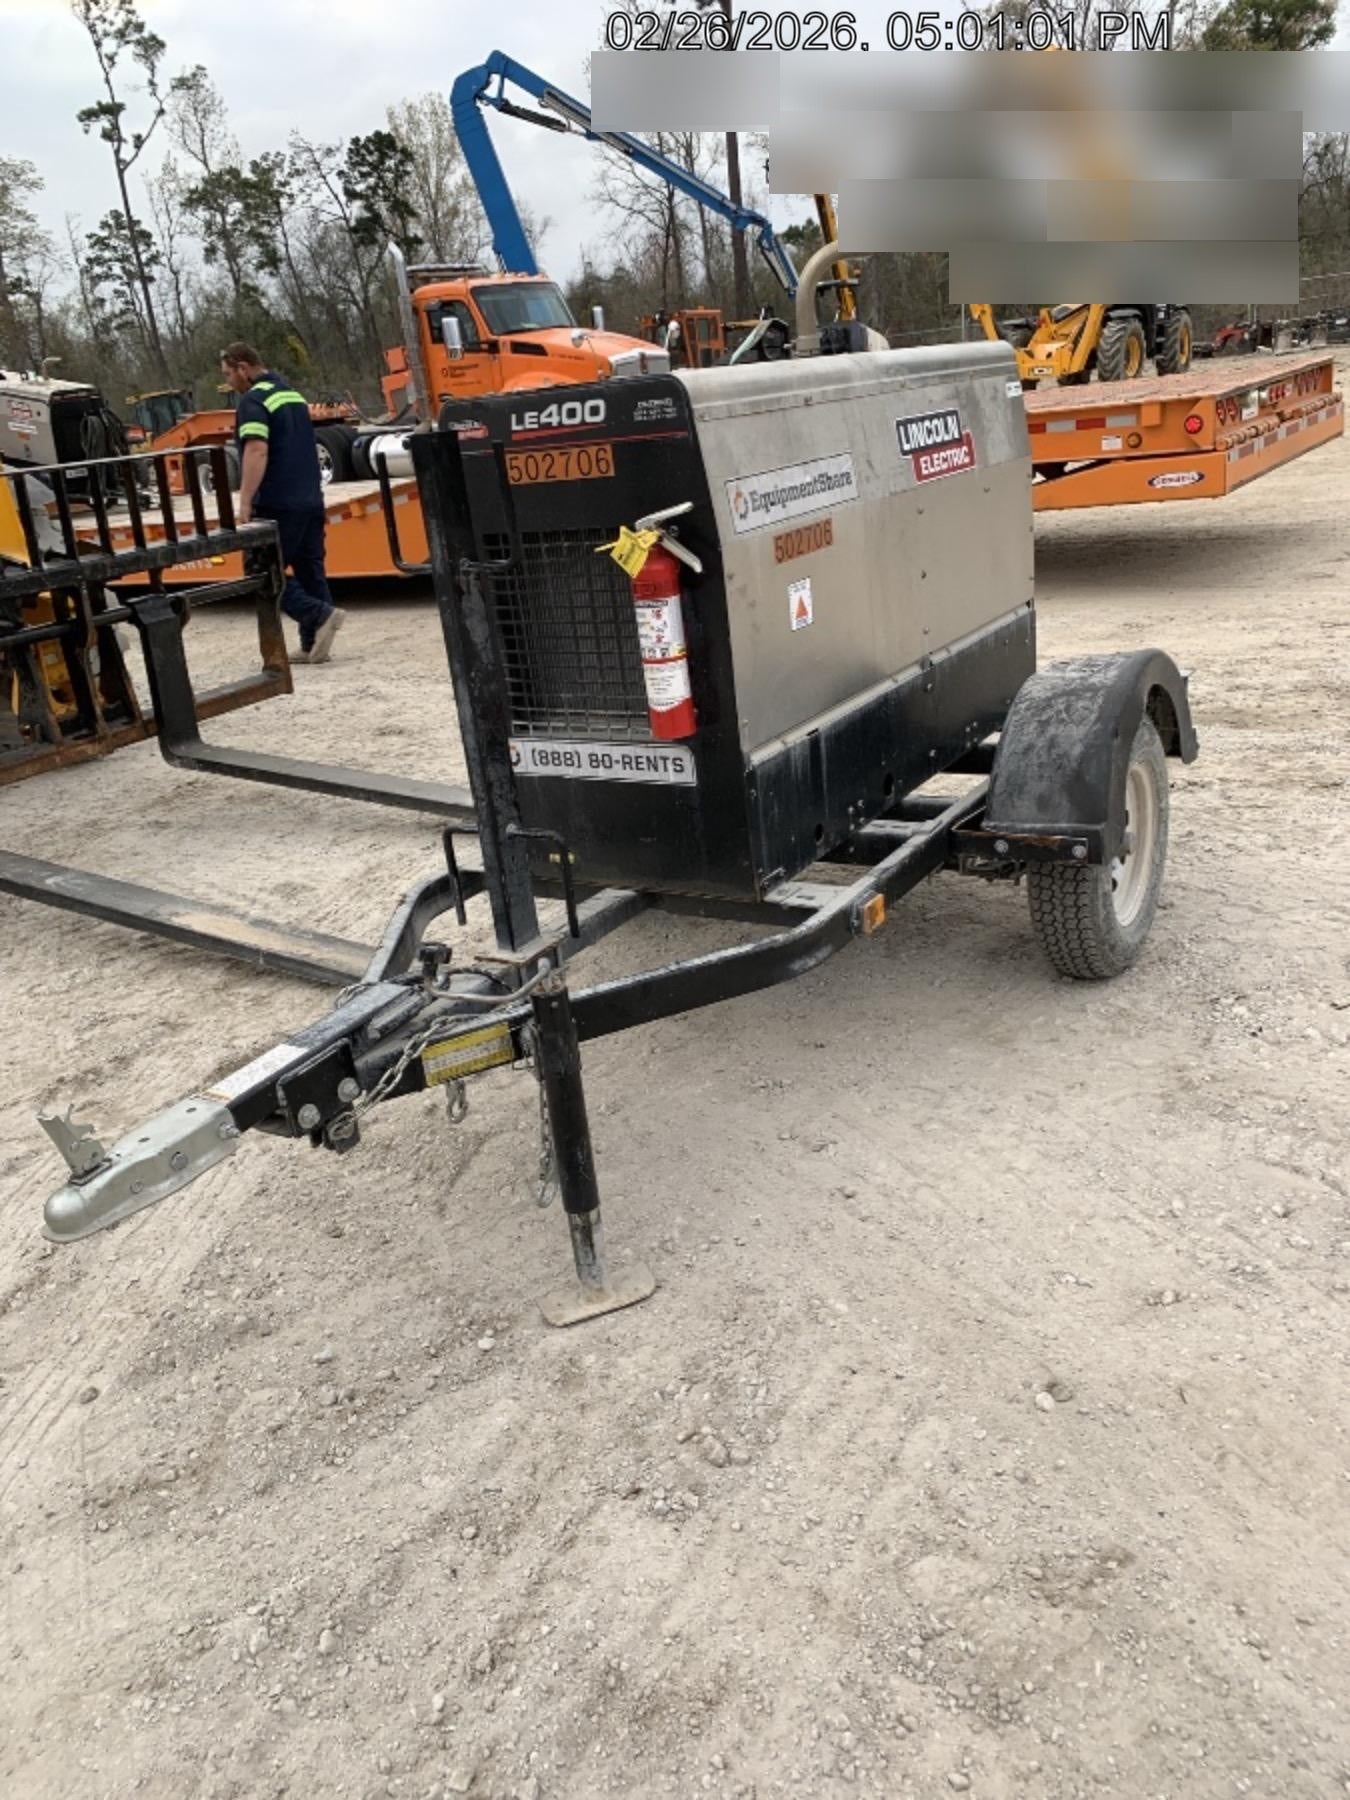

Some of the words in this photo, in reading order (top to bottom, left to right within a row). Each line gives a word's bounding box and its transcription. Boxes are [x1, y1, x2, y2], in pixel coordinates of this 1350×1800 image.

[511, 398, 606, 431] LE400
[900, 414, 960, 451] LINCOLN
[509, 447, 612, 484] 502706
[919, 446, 970, 476] ELECTRIC
[751, 470, 853, 514] EquipmentShare
[774, 519, 834, 564] 502706
[531, 748, 581, 769] (888)
[588, 752, 685, 774] 80-RENTS
